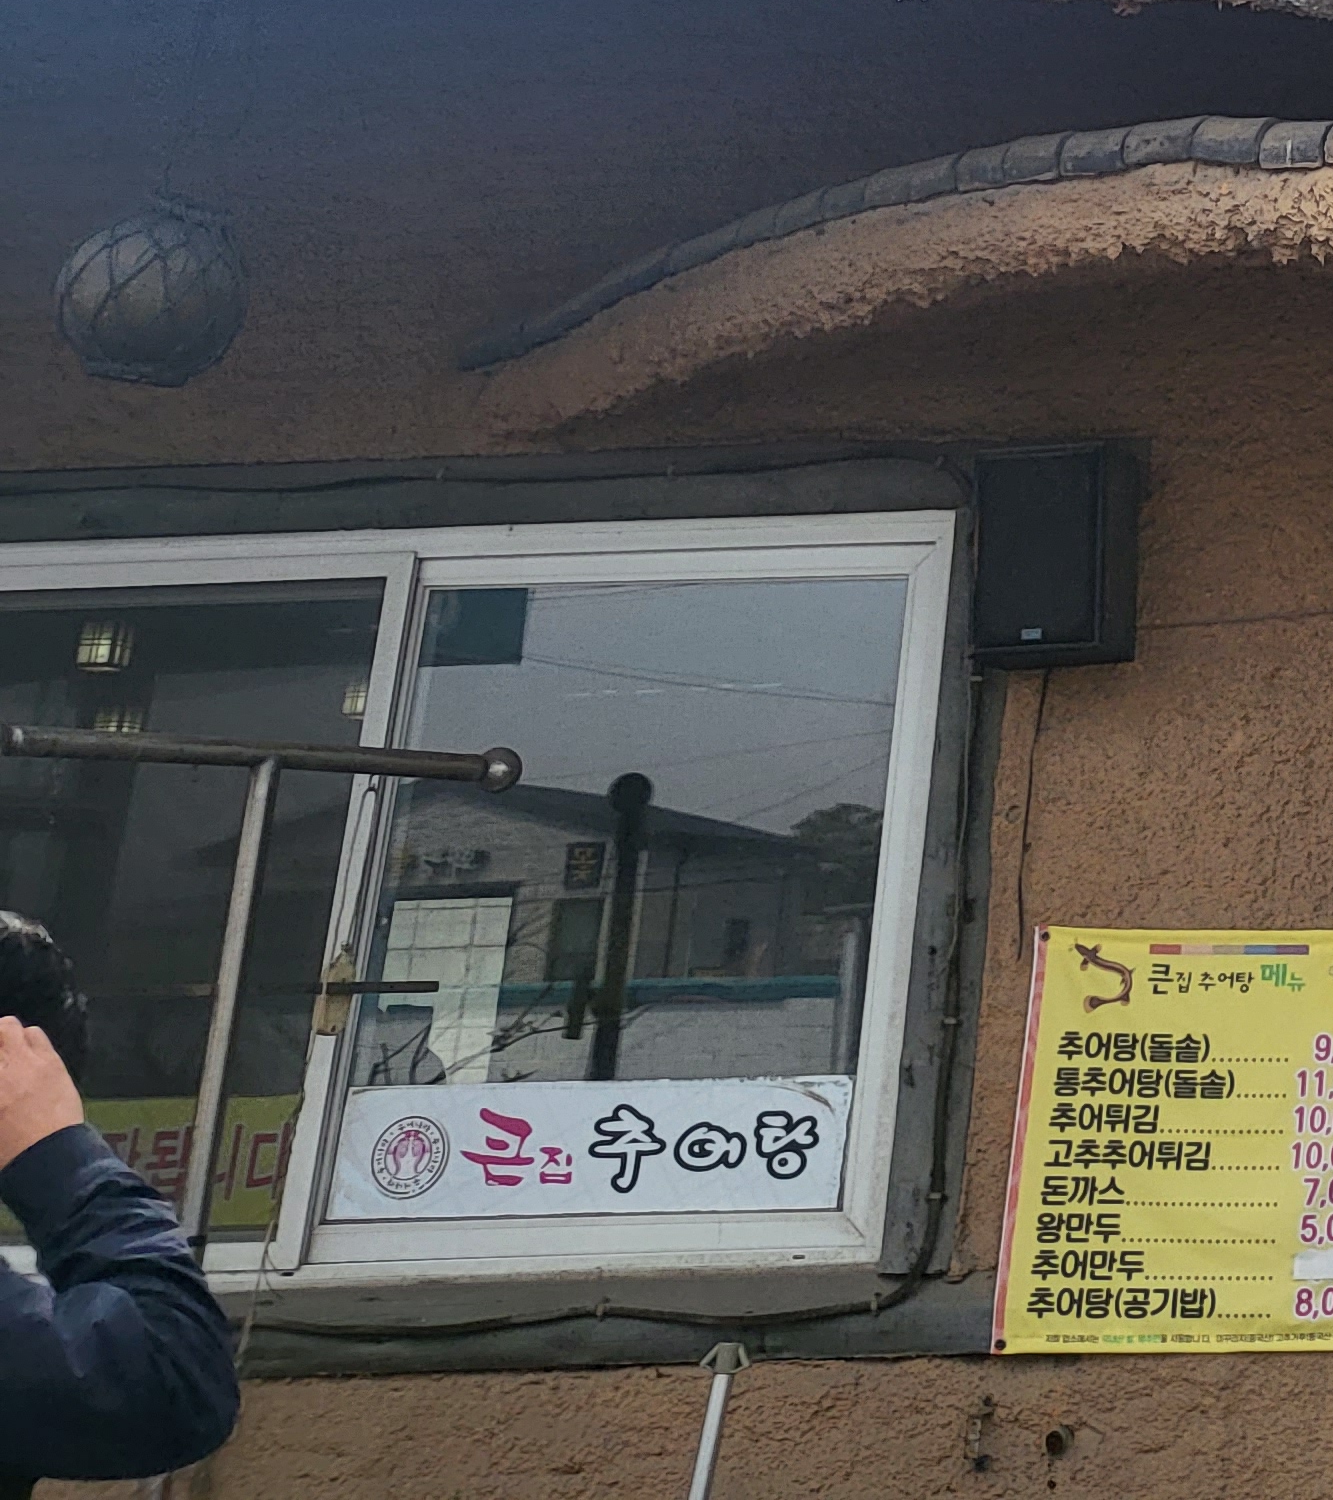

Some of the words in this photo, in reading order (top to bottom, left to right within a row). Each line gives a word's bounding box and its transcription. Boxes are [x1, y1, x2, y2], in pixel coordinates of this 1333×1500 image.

[1147, 963, 1193, 995] 큰집
[1197, 970, 1255, 994] 추어탕
[1260, 963, 1307, 993] 메뉴
[460, 1107, 574, 1187] 큰집
[588, 1104, 819, 1194] 추어탕
